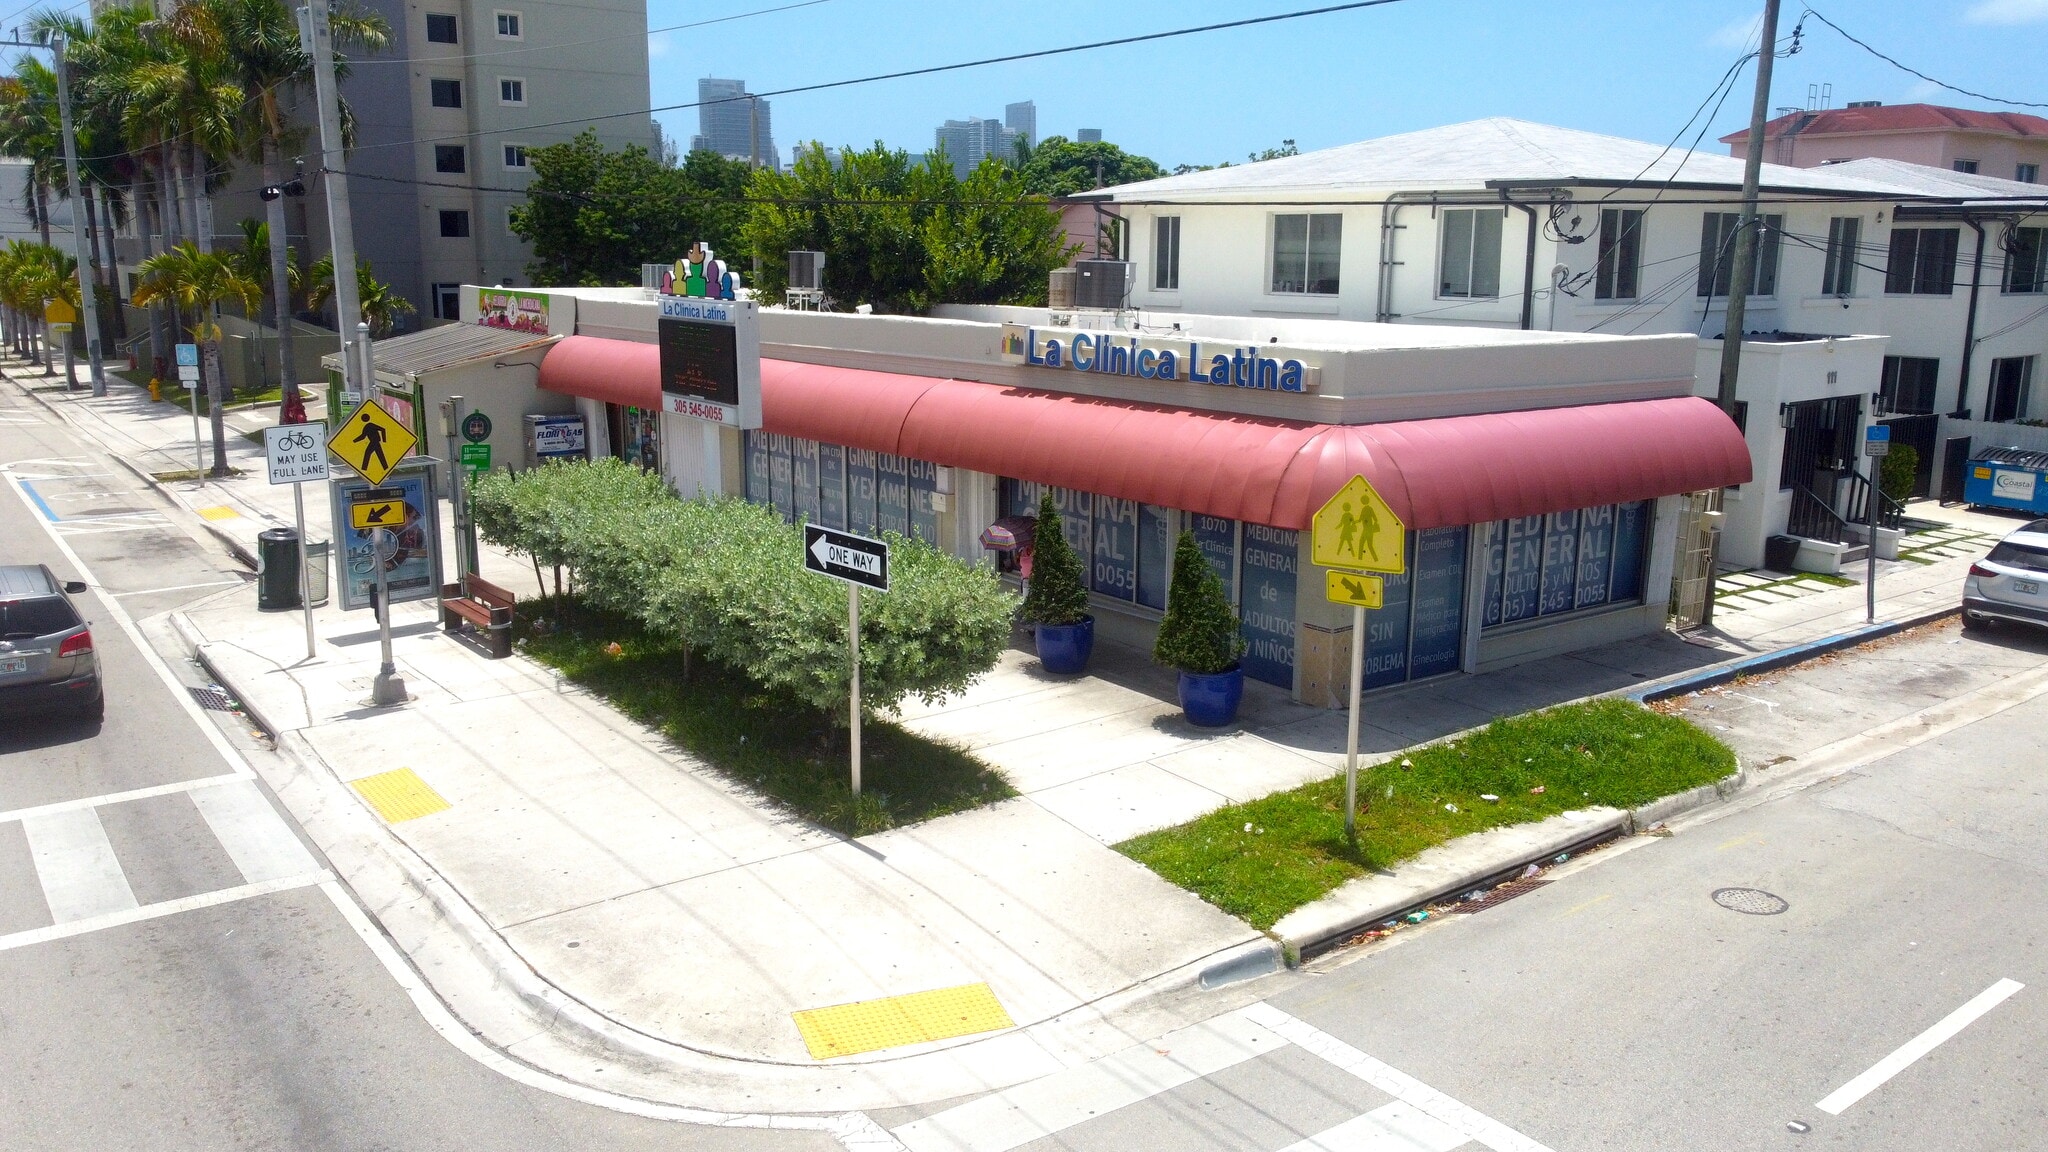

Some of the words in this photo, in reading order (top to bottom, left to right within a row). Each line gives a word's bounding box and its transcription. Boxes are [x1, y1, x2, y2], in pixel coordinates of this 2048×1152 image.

[663, 302, 673, 316] La
[674, 303, 700, 318] Clinica
[702, 306, 726, 321] Latina
[1029, 329, 1065, 368] La
[1071, 333, 1181, 380] Clinica
[1189, 342, 1308, 393] Latina
[1826, 371, 1838, 385] 111
[674, 399, 687, 413] 305
[689, 402, 723, 421] 545-0055
[277, 454, 296, 465] MAY
[301, 452, 318, 463] USE
[827, 460, 836, 471] OK
[273, 468, 297, 478] FULL
[301, 465, 325, 475] LANE
[753, 452, 812, 489] GENERAL
[2002, 477, 2033, 489] Coastal
[852, 507, 863, 524] de
[1200, 516, 1227, 534] 1070
[1489, 503, 1614, 542] MEDICINA
[1246, 523, 1299, 547] MEDICINA
[1420, 538, 1455, 553] Completo
[828, 546, 849, 565] ONE
[852, 551, 874, 571] WAY
[1245, 547, 1298, 575] GENERAL
[1487, 529, 1607, 576] GENERAL
[1418, 567, 1447, 581] Examen
[1492, 569, 1549, 599] ADULTOS
[1553, 573, 1561, 591] y
[1260, 580, 1278, 602] de
[1243, 610, 1296, 638] ADULTOS
[1370, 621, 1394, 643] SIN
[1254, 637, 1295, 667] NIÑOS
